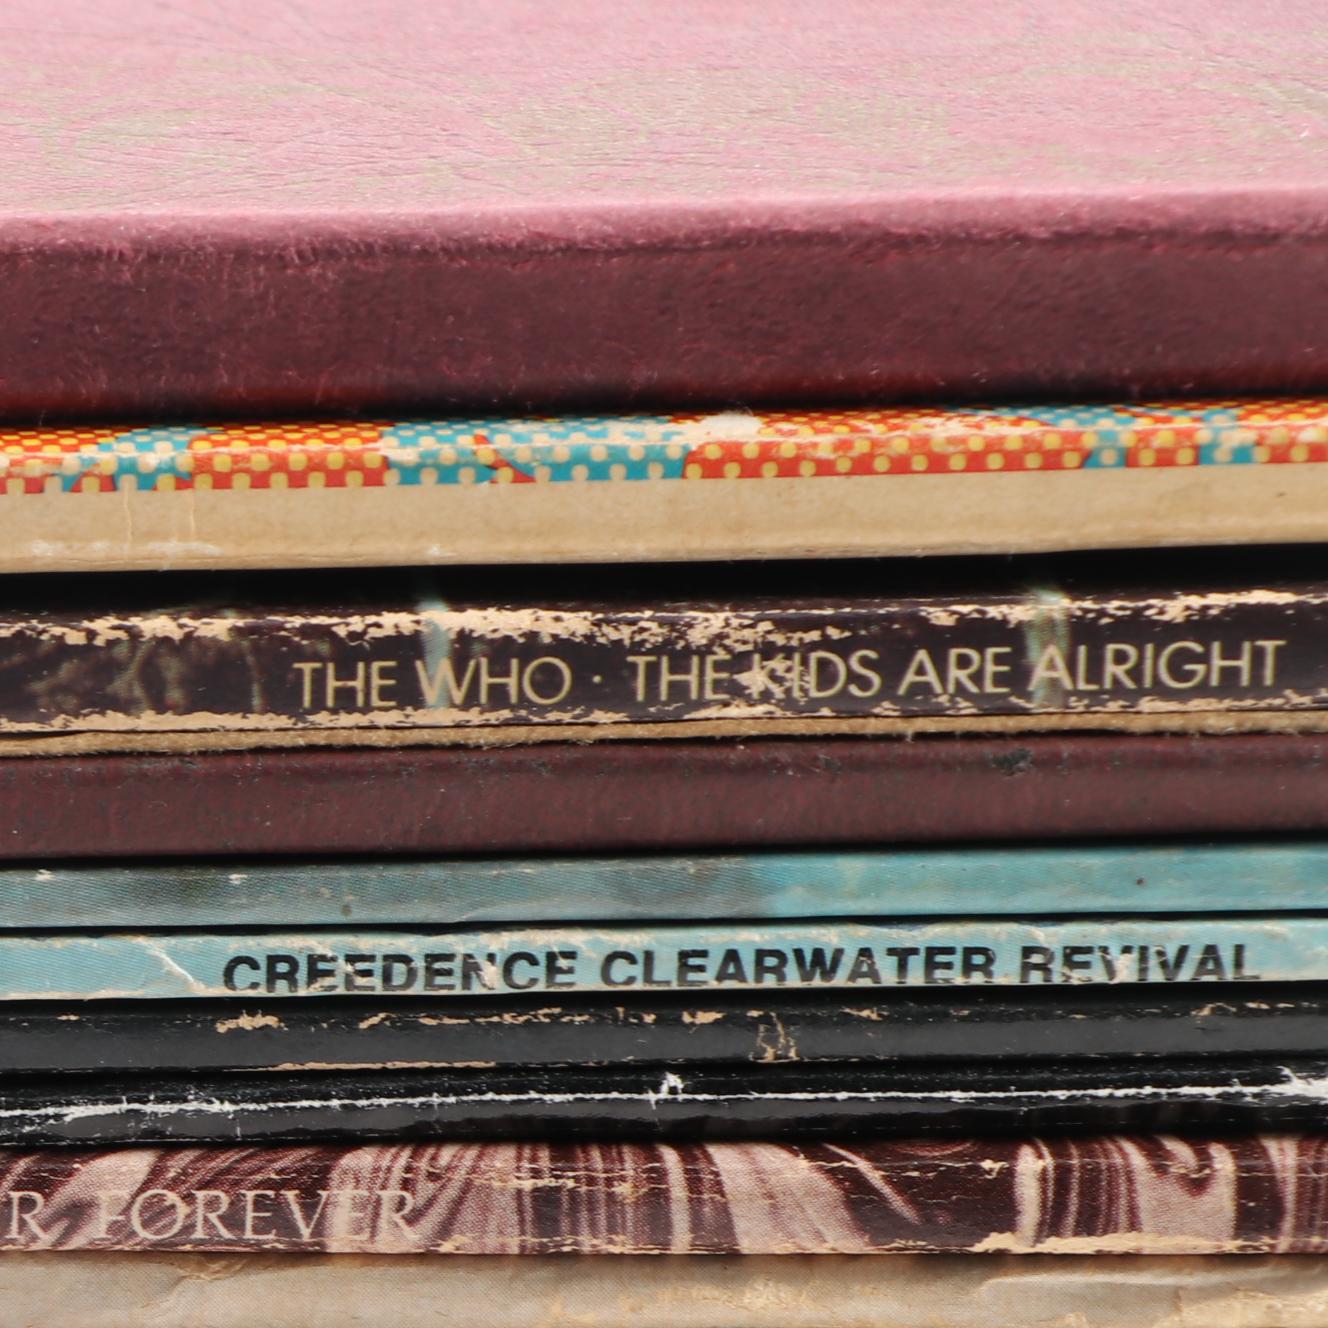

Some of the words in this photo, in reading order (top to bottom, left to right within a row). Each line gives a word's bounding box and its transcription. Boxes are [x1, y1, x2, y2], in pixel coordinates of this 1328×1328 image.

[292, 658, 397, 710] THE
[417, 654, 574, 708] WHO
[624, 652, 732, 704] THE
[740, 649, 882, 702] KIDS
[896, 646, 1014, 696] ARE
[1028, 638, 1286, 692] ALRIGHT
[222, 950, 578, 994] CREEDENCE
[599, 945, 998, 990] CLEARWATER
[1017, 943, 1262, 986] REVIVAL
[96, 1188, 422, 1240] FOREVER
